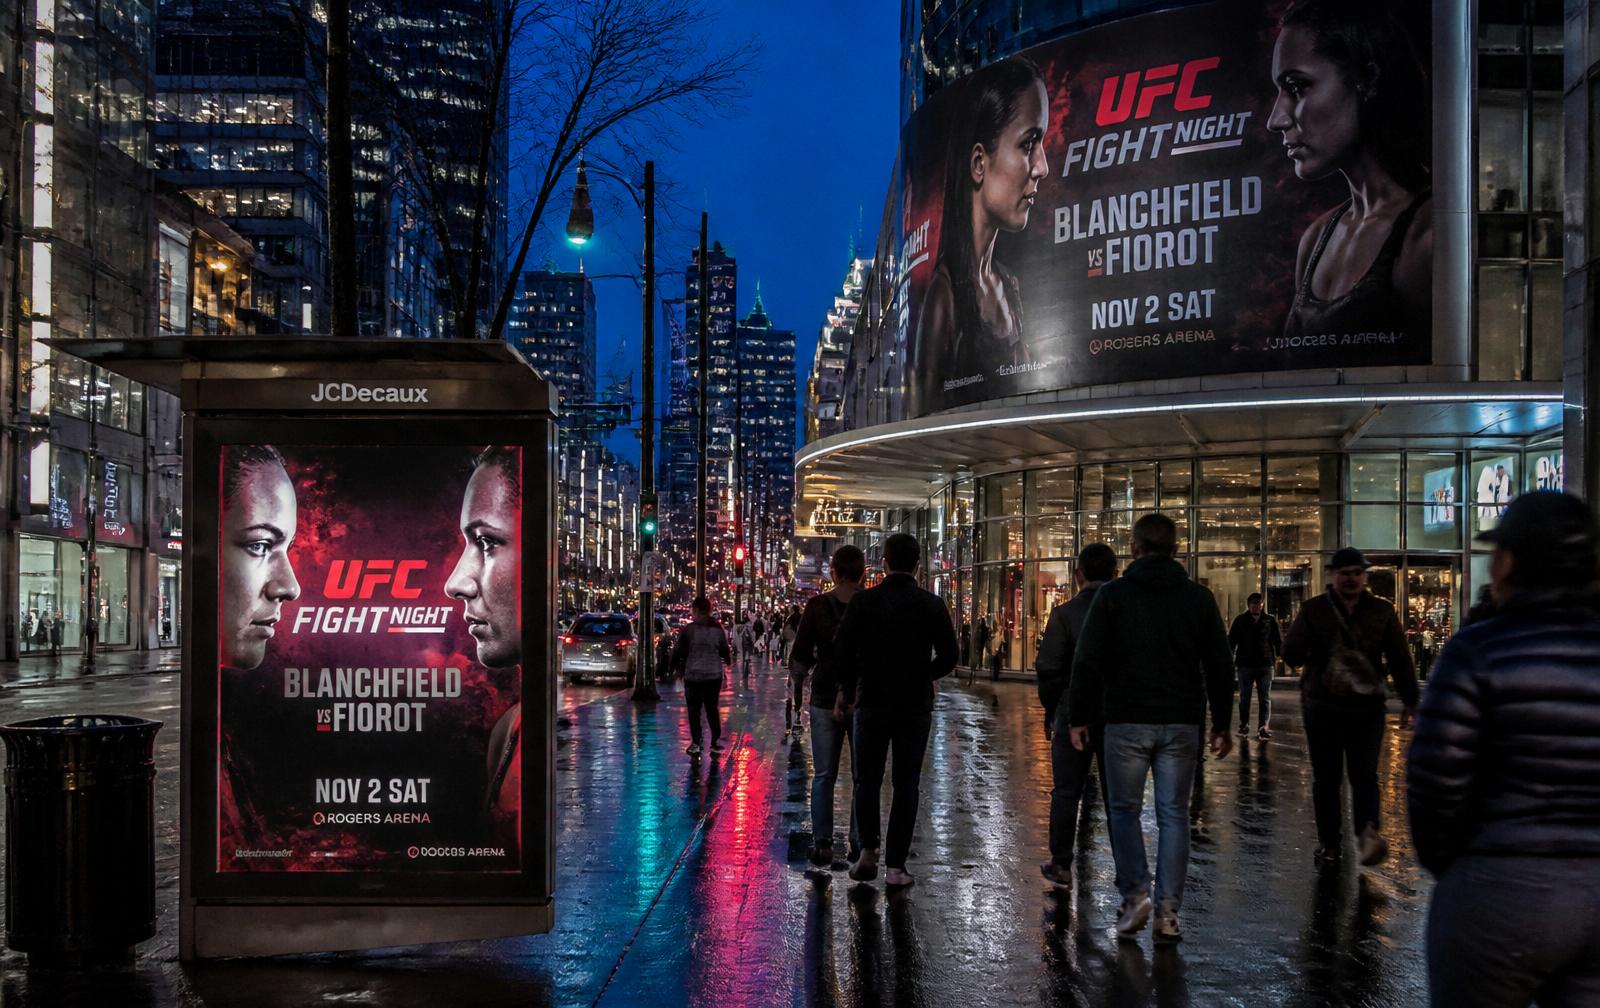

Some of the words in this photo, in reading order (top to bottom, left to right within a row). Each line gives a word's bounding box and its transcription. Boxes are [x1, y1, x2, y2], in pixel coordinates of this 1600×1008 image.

[1095, 56, 1221, 127] UFC
[1062, 123, 1172, 177] FIGHT
[1173, 111, 1252, 144] NIGHT
[1054, 176, 1262, 244] BLANCHFIELD
[1106, 225, 1219, 276] FIOROT
[1091, 298, 1138, 330] NOV
[1145, 295, 1160, 324] 2
[1168, 289, 1216, 321] SAT
[1164, 329, 1216, 346] ARENA
[311, 382, 429, 403] JCDecaux
[323, 560, 428, 599] UFC
[292, 606, 389, 633] FIGHT
[389, 606, 453, 625] NIGHT
[284, 667, 462, 698] BLANCHFIELD
[333, 703, 426, 732] FIOROT
[315, 778, 361, 803] NOV
[368, 778, 382, 803] 2
[389, 778, 431, 803] SAT
[327, 813, 381, 824] ROGERS
[384, 813, 431, 824] ARENA
